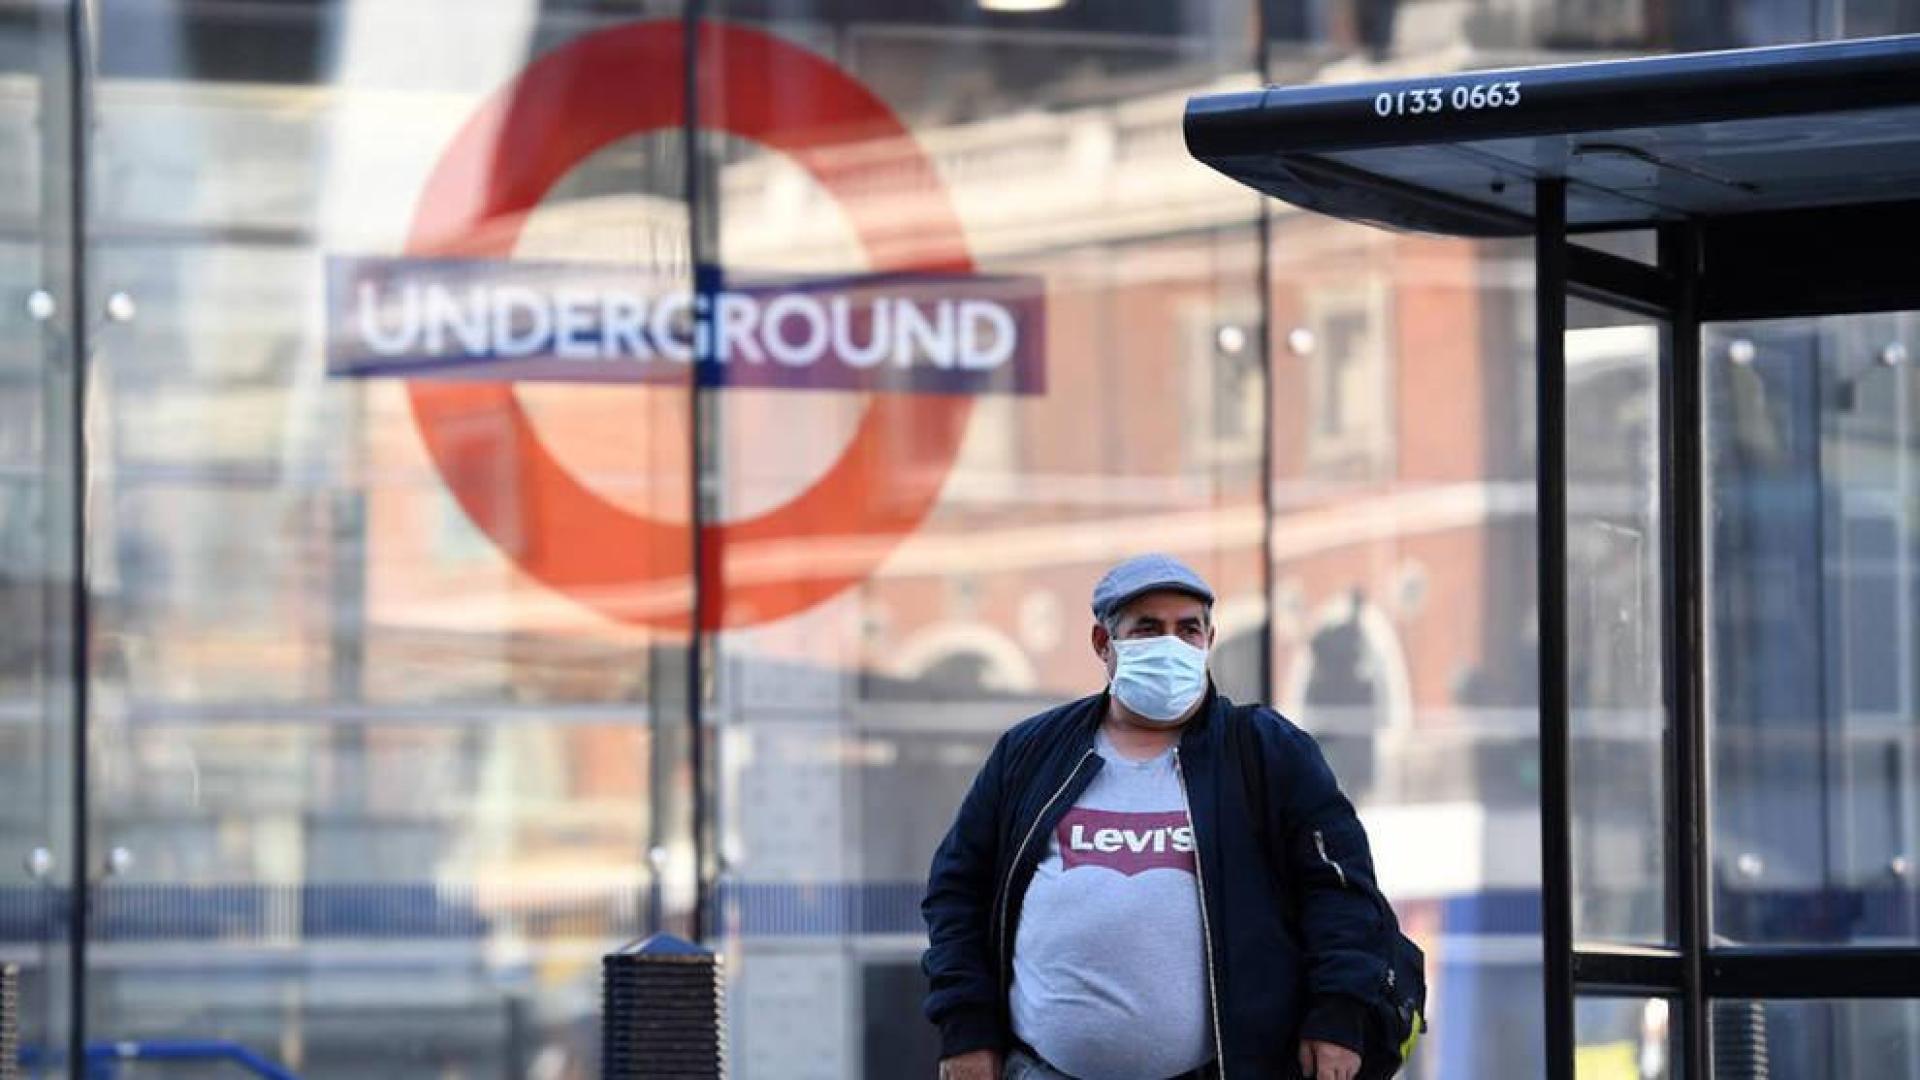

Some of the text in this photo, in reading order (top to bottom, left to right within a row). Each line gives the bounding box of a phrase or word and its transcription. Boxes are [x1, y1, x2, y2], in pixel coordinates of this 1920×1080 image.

[1375, 81, 1521, 117] 0133 0663
[356, 280, 1016, 372] UNDERGROUND
